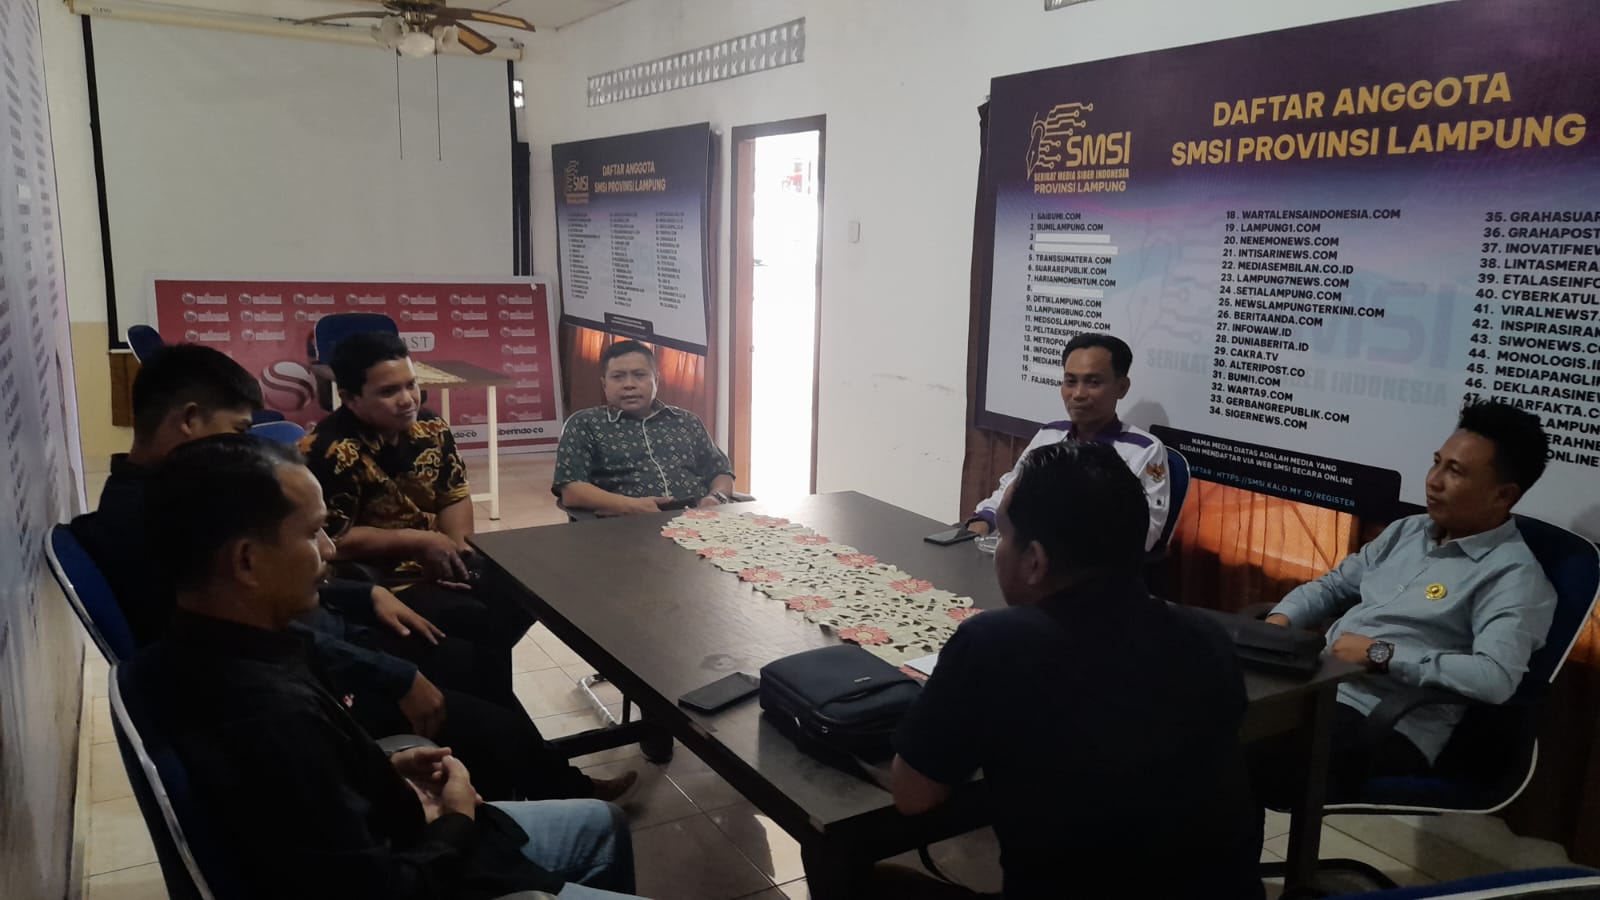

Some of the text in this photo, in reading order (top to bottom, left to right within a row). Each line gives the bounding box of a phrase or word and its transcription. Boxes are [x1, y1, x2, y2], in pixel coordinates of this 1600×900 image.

[1213, 72, 1512, 127] DAFTAR ANGGOTA
[1171, 113, 1587, 166] SMSI PROVINSI LAMPUNG
[1066, 131, 1131, 167] SMSI
[603, 161, 655, 176] DAFTAR ANGGOTA
[1096, 168, 1129, 178] INDONESIA
[635, 179, 666, 191] LAMPUNG
[1034, 181, 1126, 194] PROVINSI LAMPUNG
[1226, 209, 1401, 219] 18. WARTALENSAINDONESIA.COM
[1485, 212, 1507, 222] 35.
[1037, 223, 1103, 231] BUMILAMPUNG.COM
[1225, 223, 1320, 233] 19. LAMPUNG1.COM
[1483, 227, 1505, 238] 36.
[1224, 236, 1339, 246] 20. NENEMONEWS.COM
[1223, 249, 1337, 260] 21. INTISARINEWS.COM
[1481, 243, 1502, 253] 37.
[1035, 254, 1112, 265] TRANSSUMATERA.COM
[1480, 258, 1501, 269] 38.
[1034, 264, 1107, 275] SUARAREPUBLIK.COM
[1222, 261, 1353, 274] 22. MEDIASEMBILAN.CO.ID
[1034, 275, 1116, 287] HARIANMOMENTUM.COM
[1221, 273, 1349, 288] 23. LAMPUNG7NEWS.COM
[1478, 273, 1499, 284] 39.
[1476, 289, 1498, 299] 40.
[1033, 295, 1102, 308] DETIKLAMPUNG.COM
[1218, 298, 1385, 318] 25. NEWSLAMPUNGTERKINI.COM
[1034, 305, 1102, 318] LAMPUNGBUNG.COM
[1474, 304, 1494, 315] 41.
[1033, 315, 1111, 330] MEDSOSLAMPUNG.COM
[1217, 310, 1323, 327] 26. BERITAANDA.COM
[1472, 319, 1493, 330] 42.
[1216, 322, 1292, 337] 27. INFOWAW.ID
[1215, 334, 1309, 352] 28. DUNIABERITA.ID
[1470, 334, 1600, 354] 43. SIWONEWS.C
[1214, 346, 1279, 361] 29. CAKRA.TV
[1468, 348, 1490, 359] 44.
[1213, 358, 1228, 368] 30.
[1229, 360, 1305, 377] ALTERIPOST.CO
[1466, 363, 1488, 374] 45.
[1212, 370, 1226, 380] 31.
[1228, 372, 1281, 387] BUMI1.COM
[1465, 378, 1486, 389] 46.
[1211, 382, 1293, 402] 32. WARTA9.COM
[1210, 394, 1350, 424] 33. GERBANGREPUBLIK.COM
[1209, 406, 1308, 430] 34. SIGERNEWS.COM
[1192, 438, 1337, 472] NAMA MEDIA DIATAS ADALAH MEDIA YANG
[1179, 443, 1353, 485] SUDAH MENDAFTAR VIA WEB SMSI SECARA ONLINE
